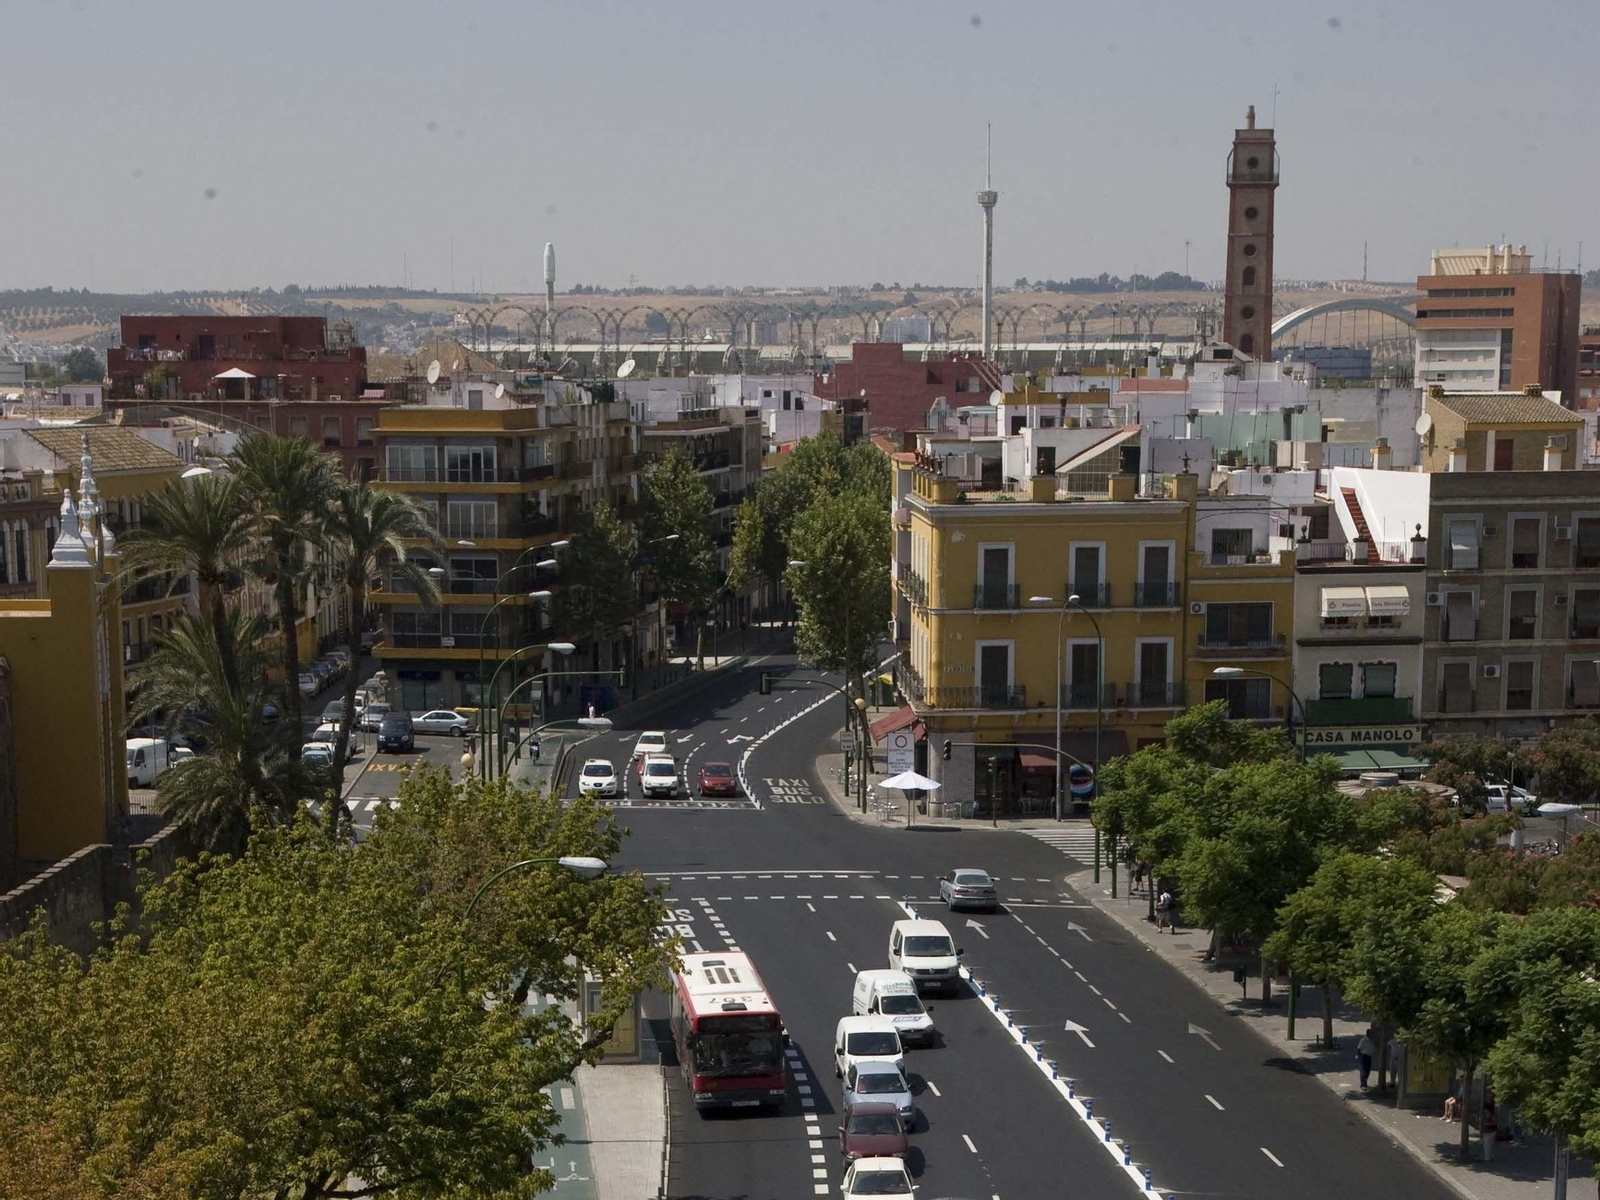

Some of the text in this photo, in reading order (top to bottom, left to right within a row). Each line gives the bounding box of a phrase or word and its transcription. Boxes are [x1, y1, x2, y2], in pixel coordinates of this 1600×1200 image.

[1305, 730, 1413, 743] CASA MANOLO
[762, 778, 810, 788] TAXI
[770, 786, 812, 796] BUS
[768, 795, 826, 804] SOLO
